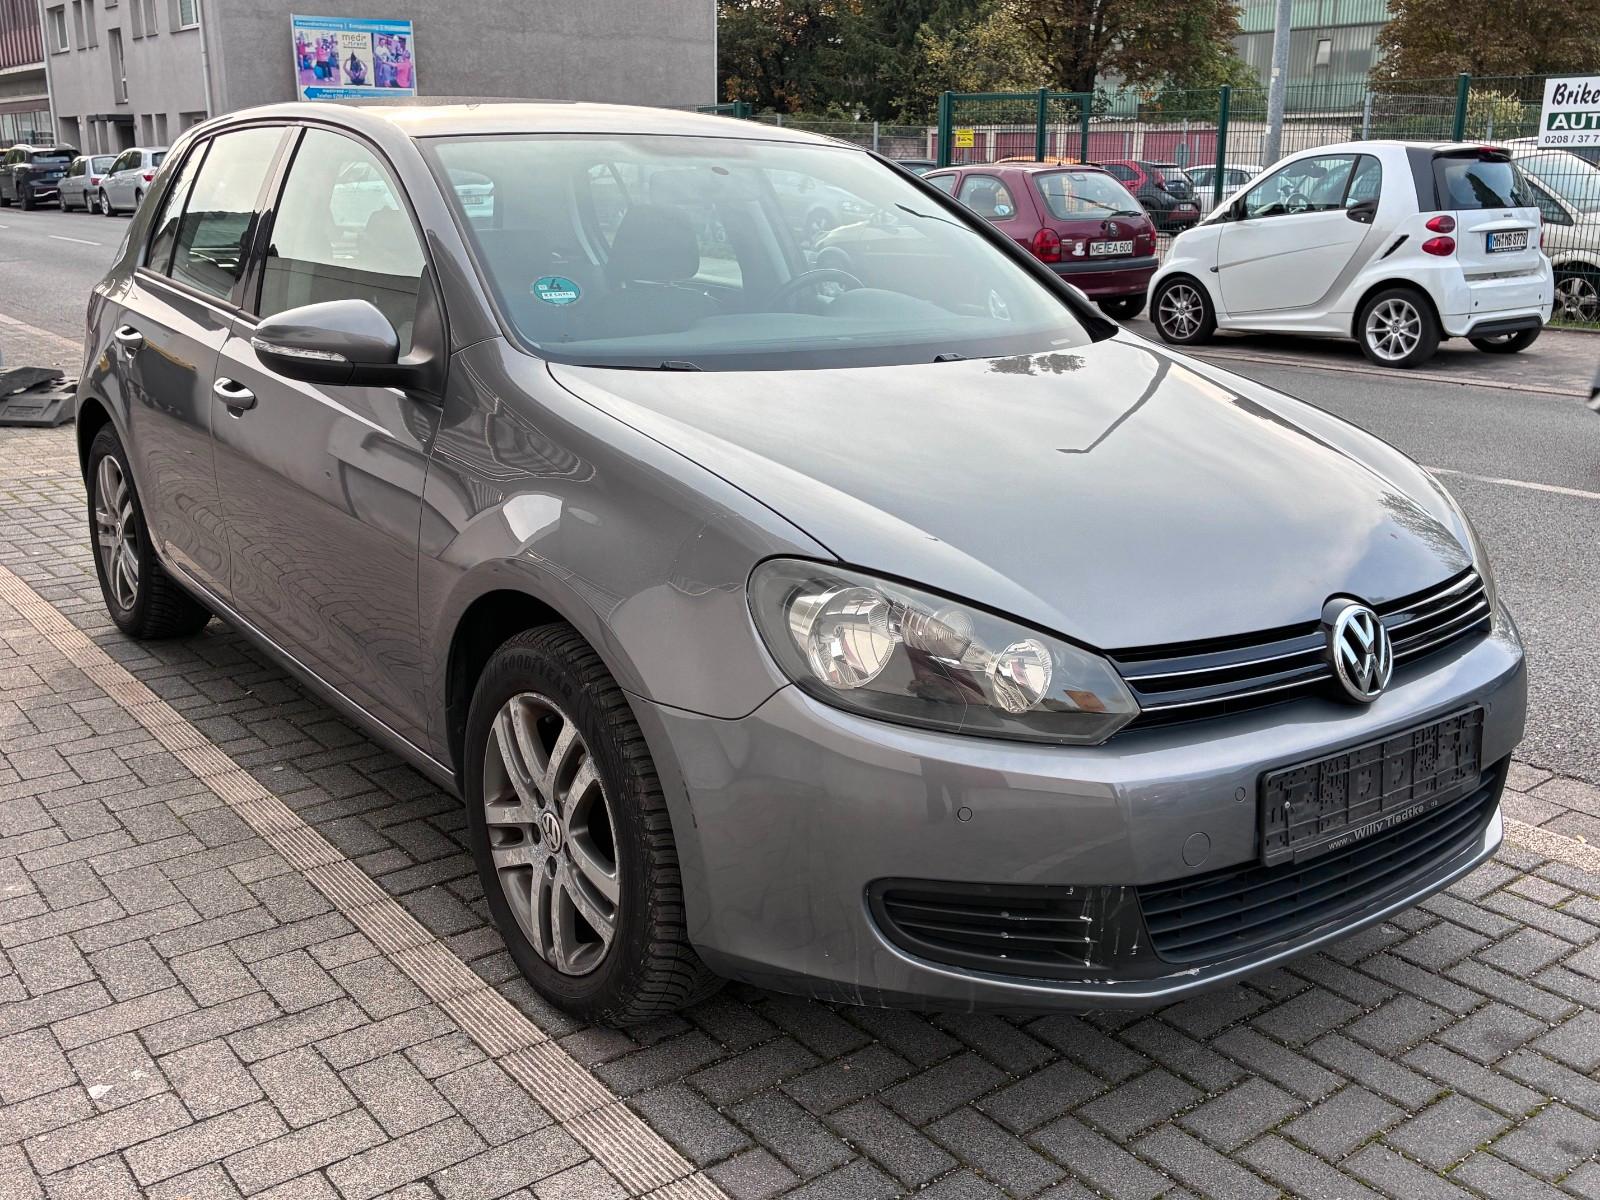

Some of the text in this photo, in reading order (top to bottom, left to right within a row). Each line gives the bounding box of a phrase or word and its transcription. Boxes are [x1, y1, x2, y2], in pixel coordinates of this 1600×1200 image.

[1552, 82, 1600, 106] Brike
[1551, 113, 1600, 130] AUT
[1545, 135, 1568, 144] 0208
[1578, 134, 1590, 143] 37
[1355, 823, 1383, 840] Willy
